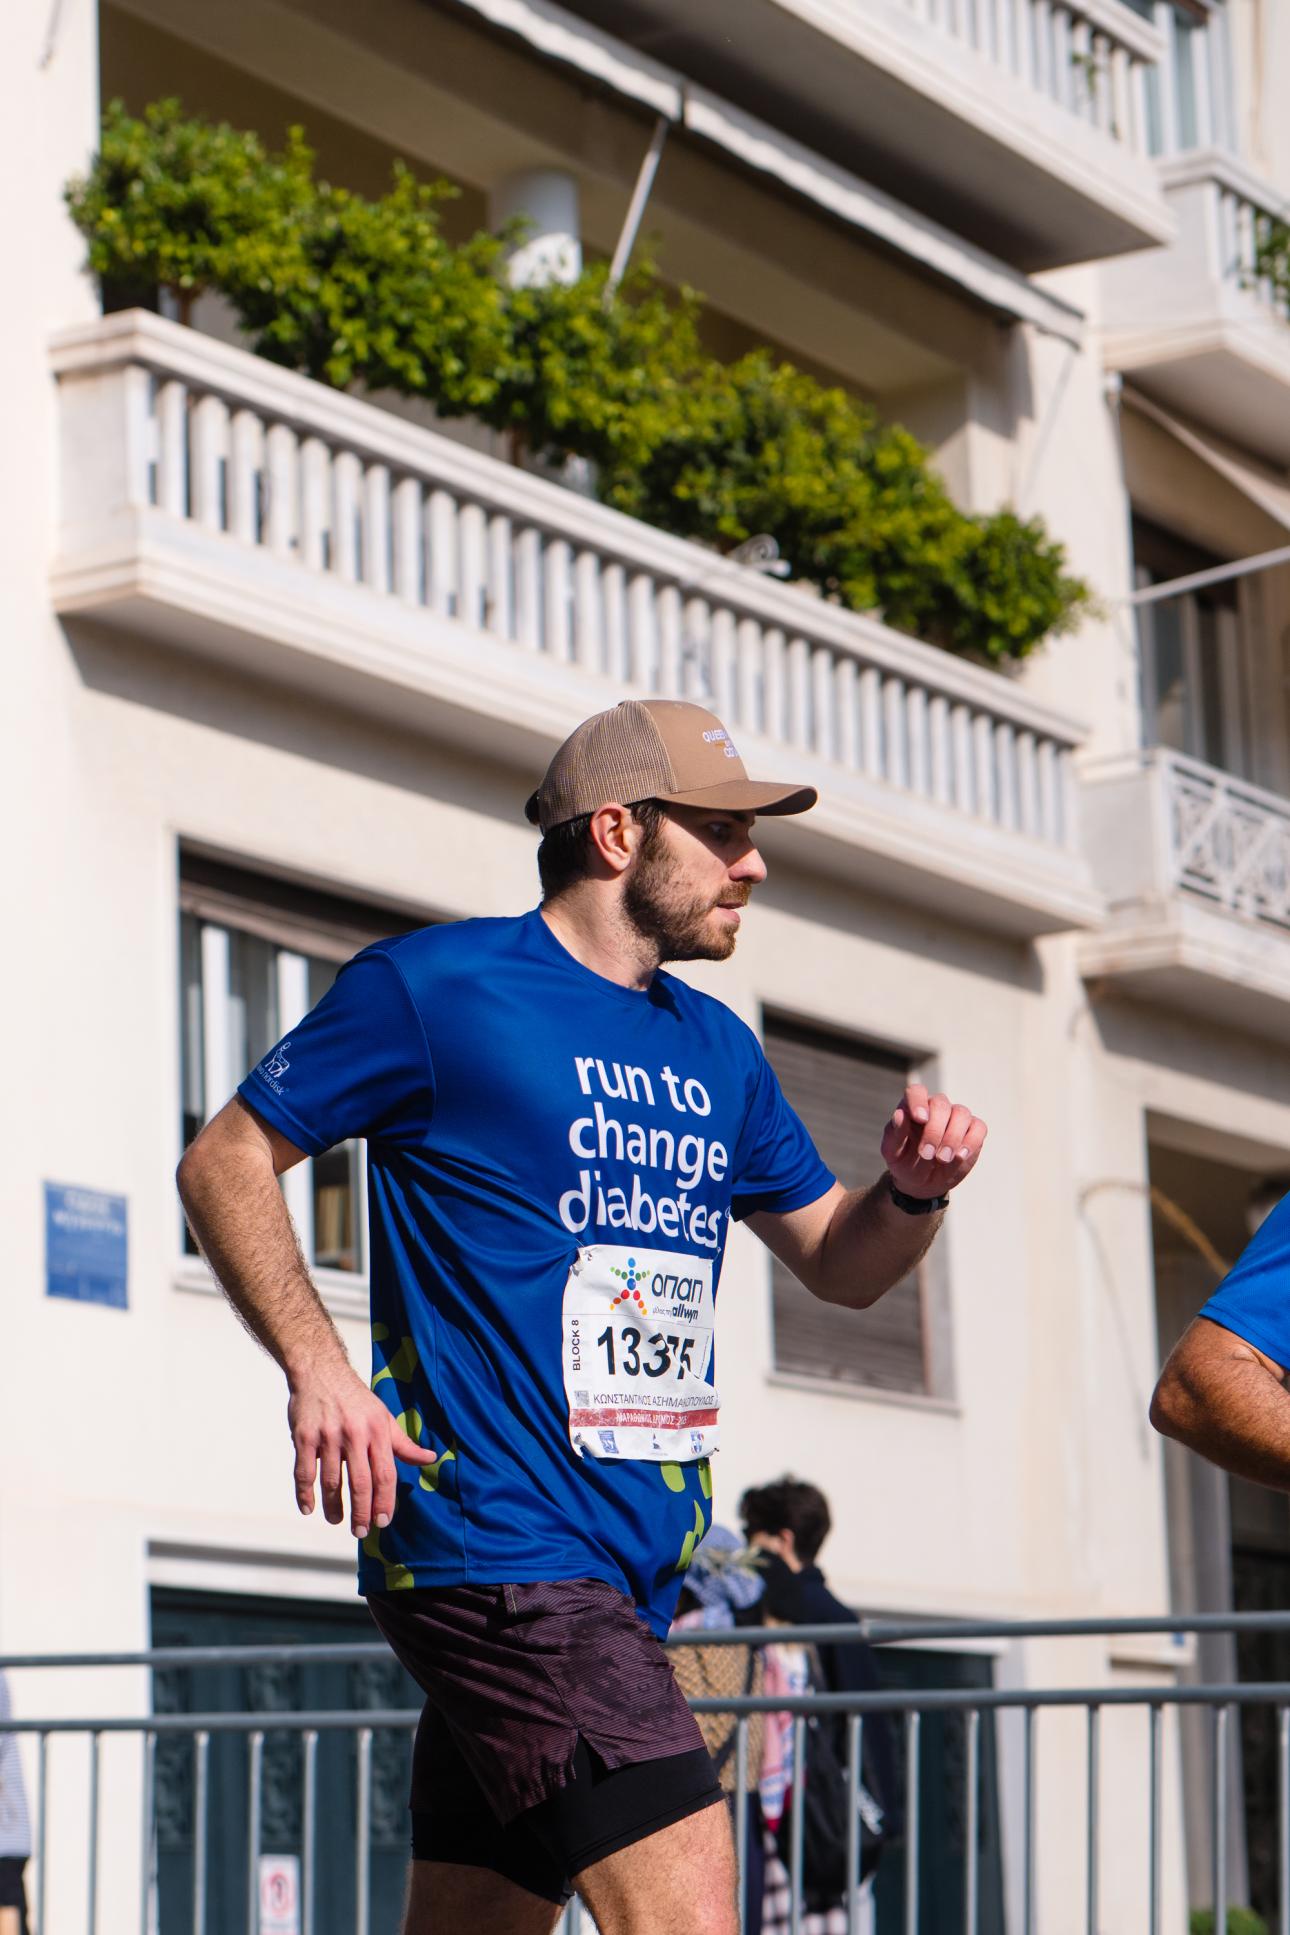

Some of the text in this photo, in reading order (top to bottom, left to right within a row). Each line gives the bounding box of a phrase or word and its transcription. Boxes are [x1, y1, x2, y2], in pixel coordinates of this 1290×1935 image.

[574, 1056, 712, 1117] run to
[568, 1101, 729, 1190] change
[558, 1169, 723, 1249] diabetes
[672, 1303, 699, 1323] allwyn
[571, 1329, 581, 1371] BLOCK
